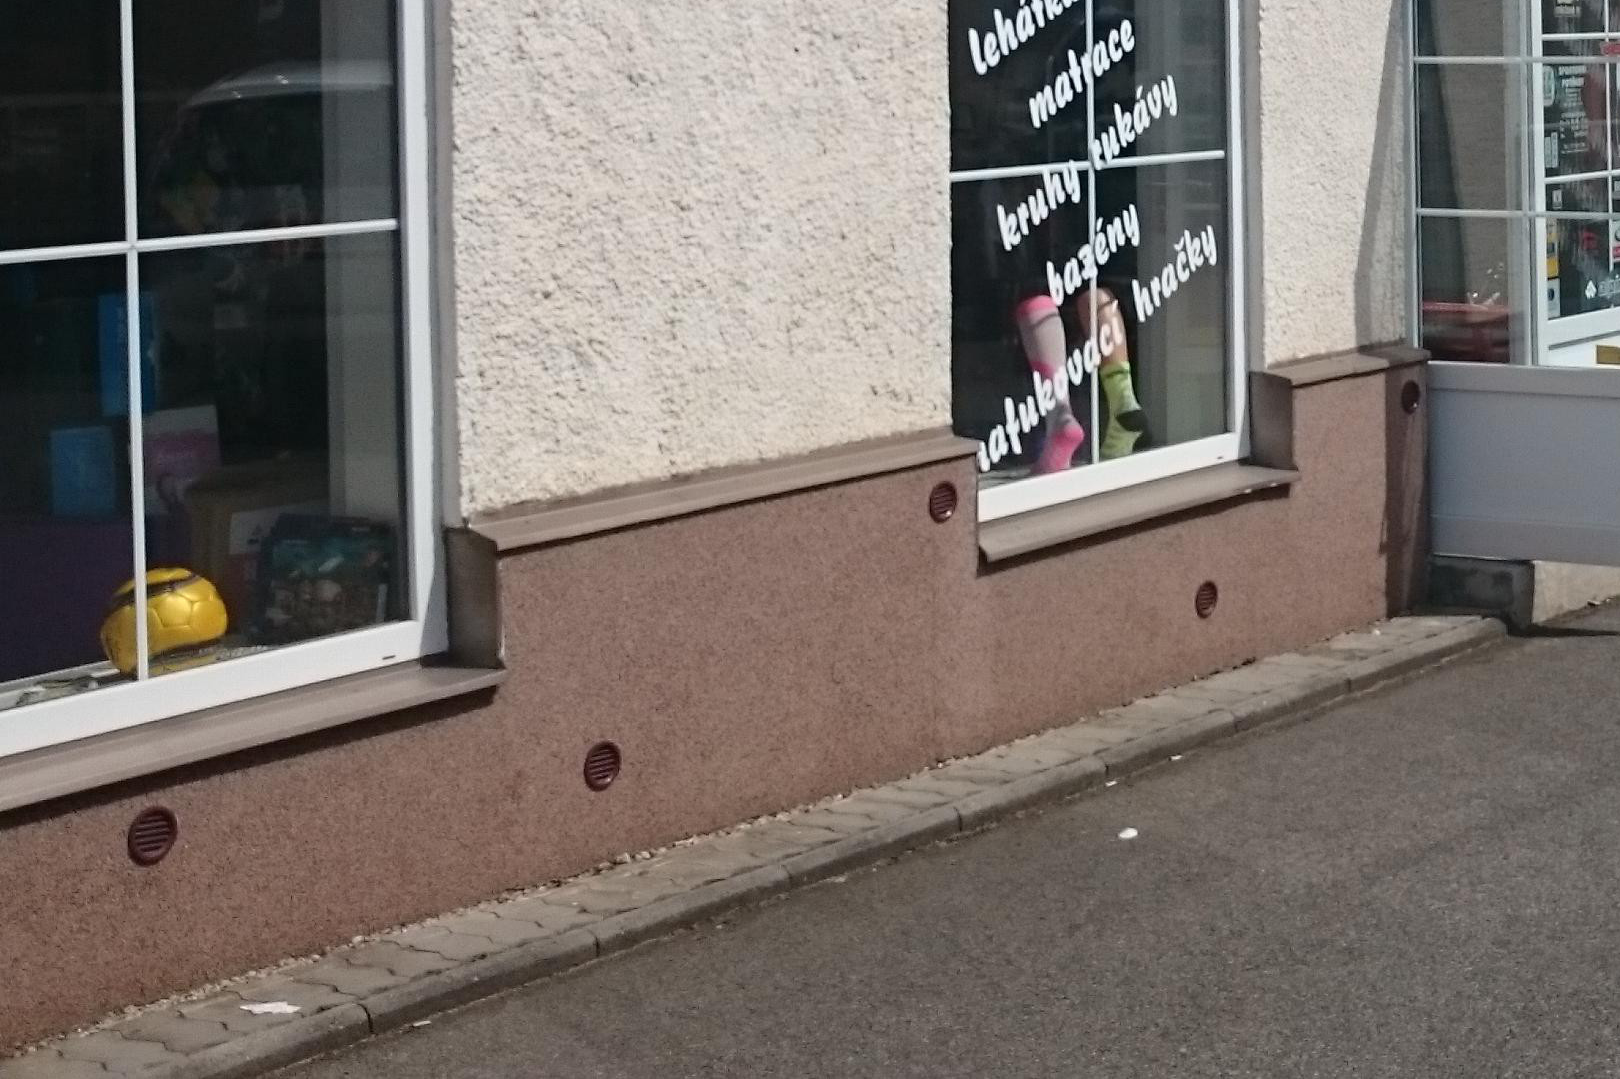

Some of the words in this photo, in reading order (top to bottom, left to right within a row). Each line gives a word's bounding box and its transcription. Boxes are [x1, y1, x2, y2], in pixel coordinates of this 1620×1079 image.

[1029, 19, 1136, 128] matrace
[997, 160, 1081, 251] kruhy
[1091, 75, 1178, 170] rukávy
[1046, 204, 1141, 307] bazény
[1132, 225, 1218, 322] hračky
